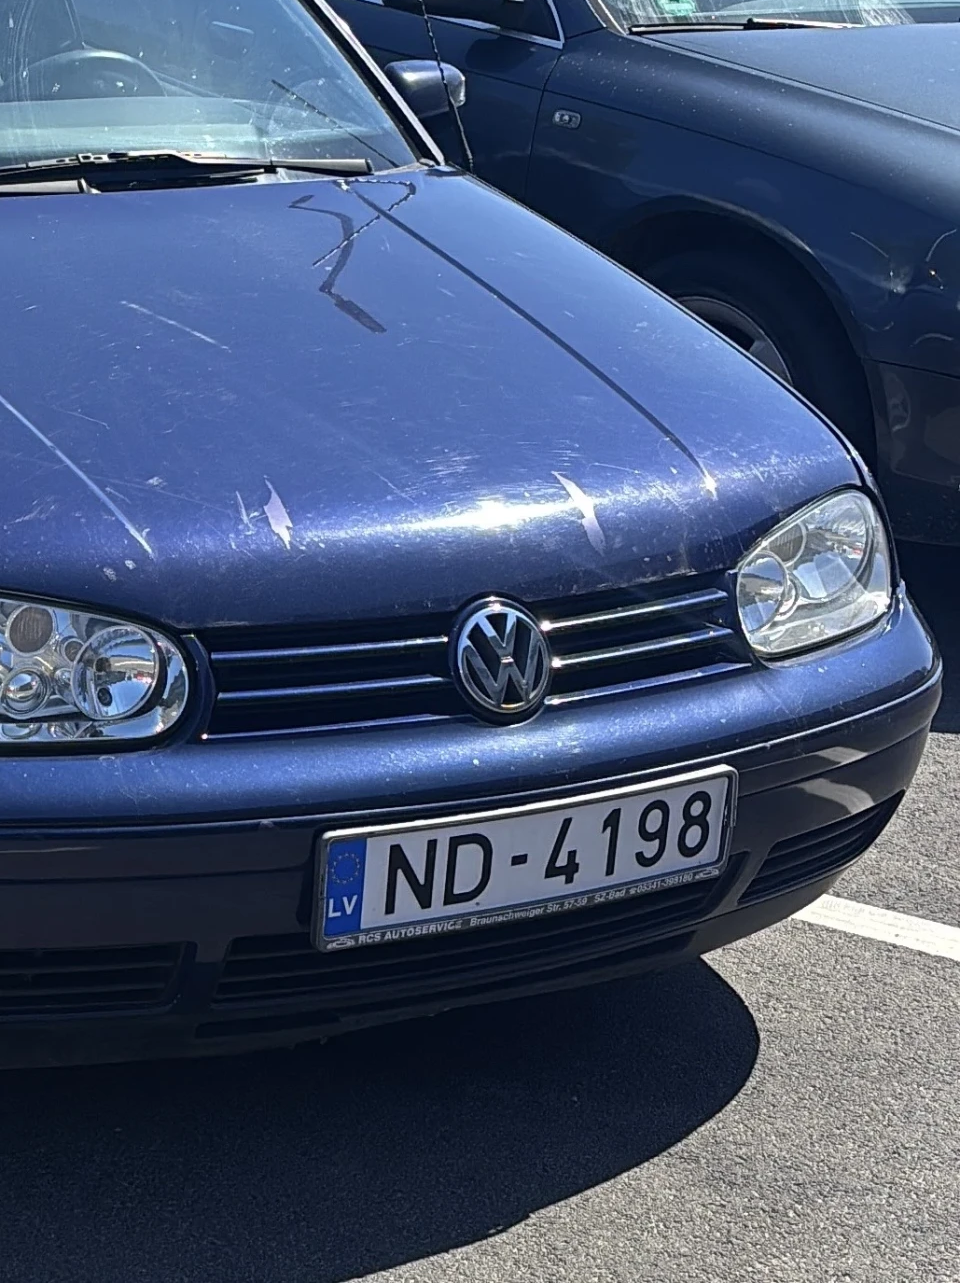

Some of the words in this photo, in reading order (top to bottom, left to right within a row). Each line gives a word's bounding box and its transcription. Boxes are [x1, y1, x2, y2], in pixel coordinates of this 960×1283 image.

[327, 894, 358, 918] LV
[358, 932, 381, 945] RCS
[470, 907, 545, 927] Braunschweiger
[546, 903, 561, 913] Str.
